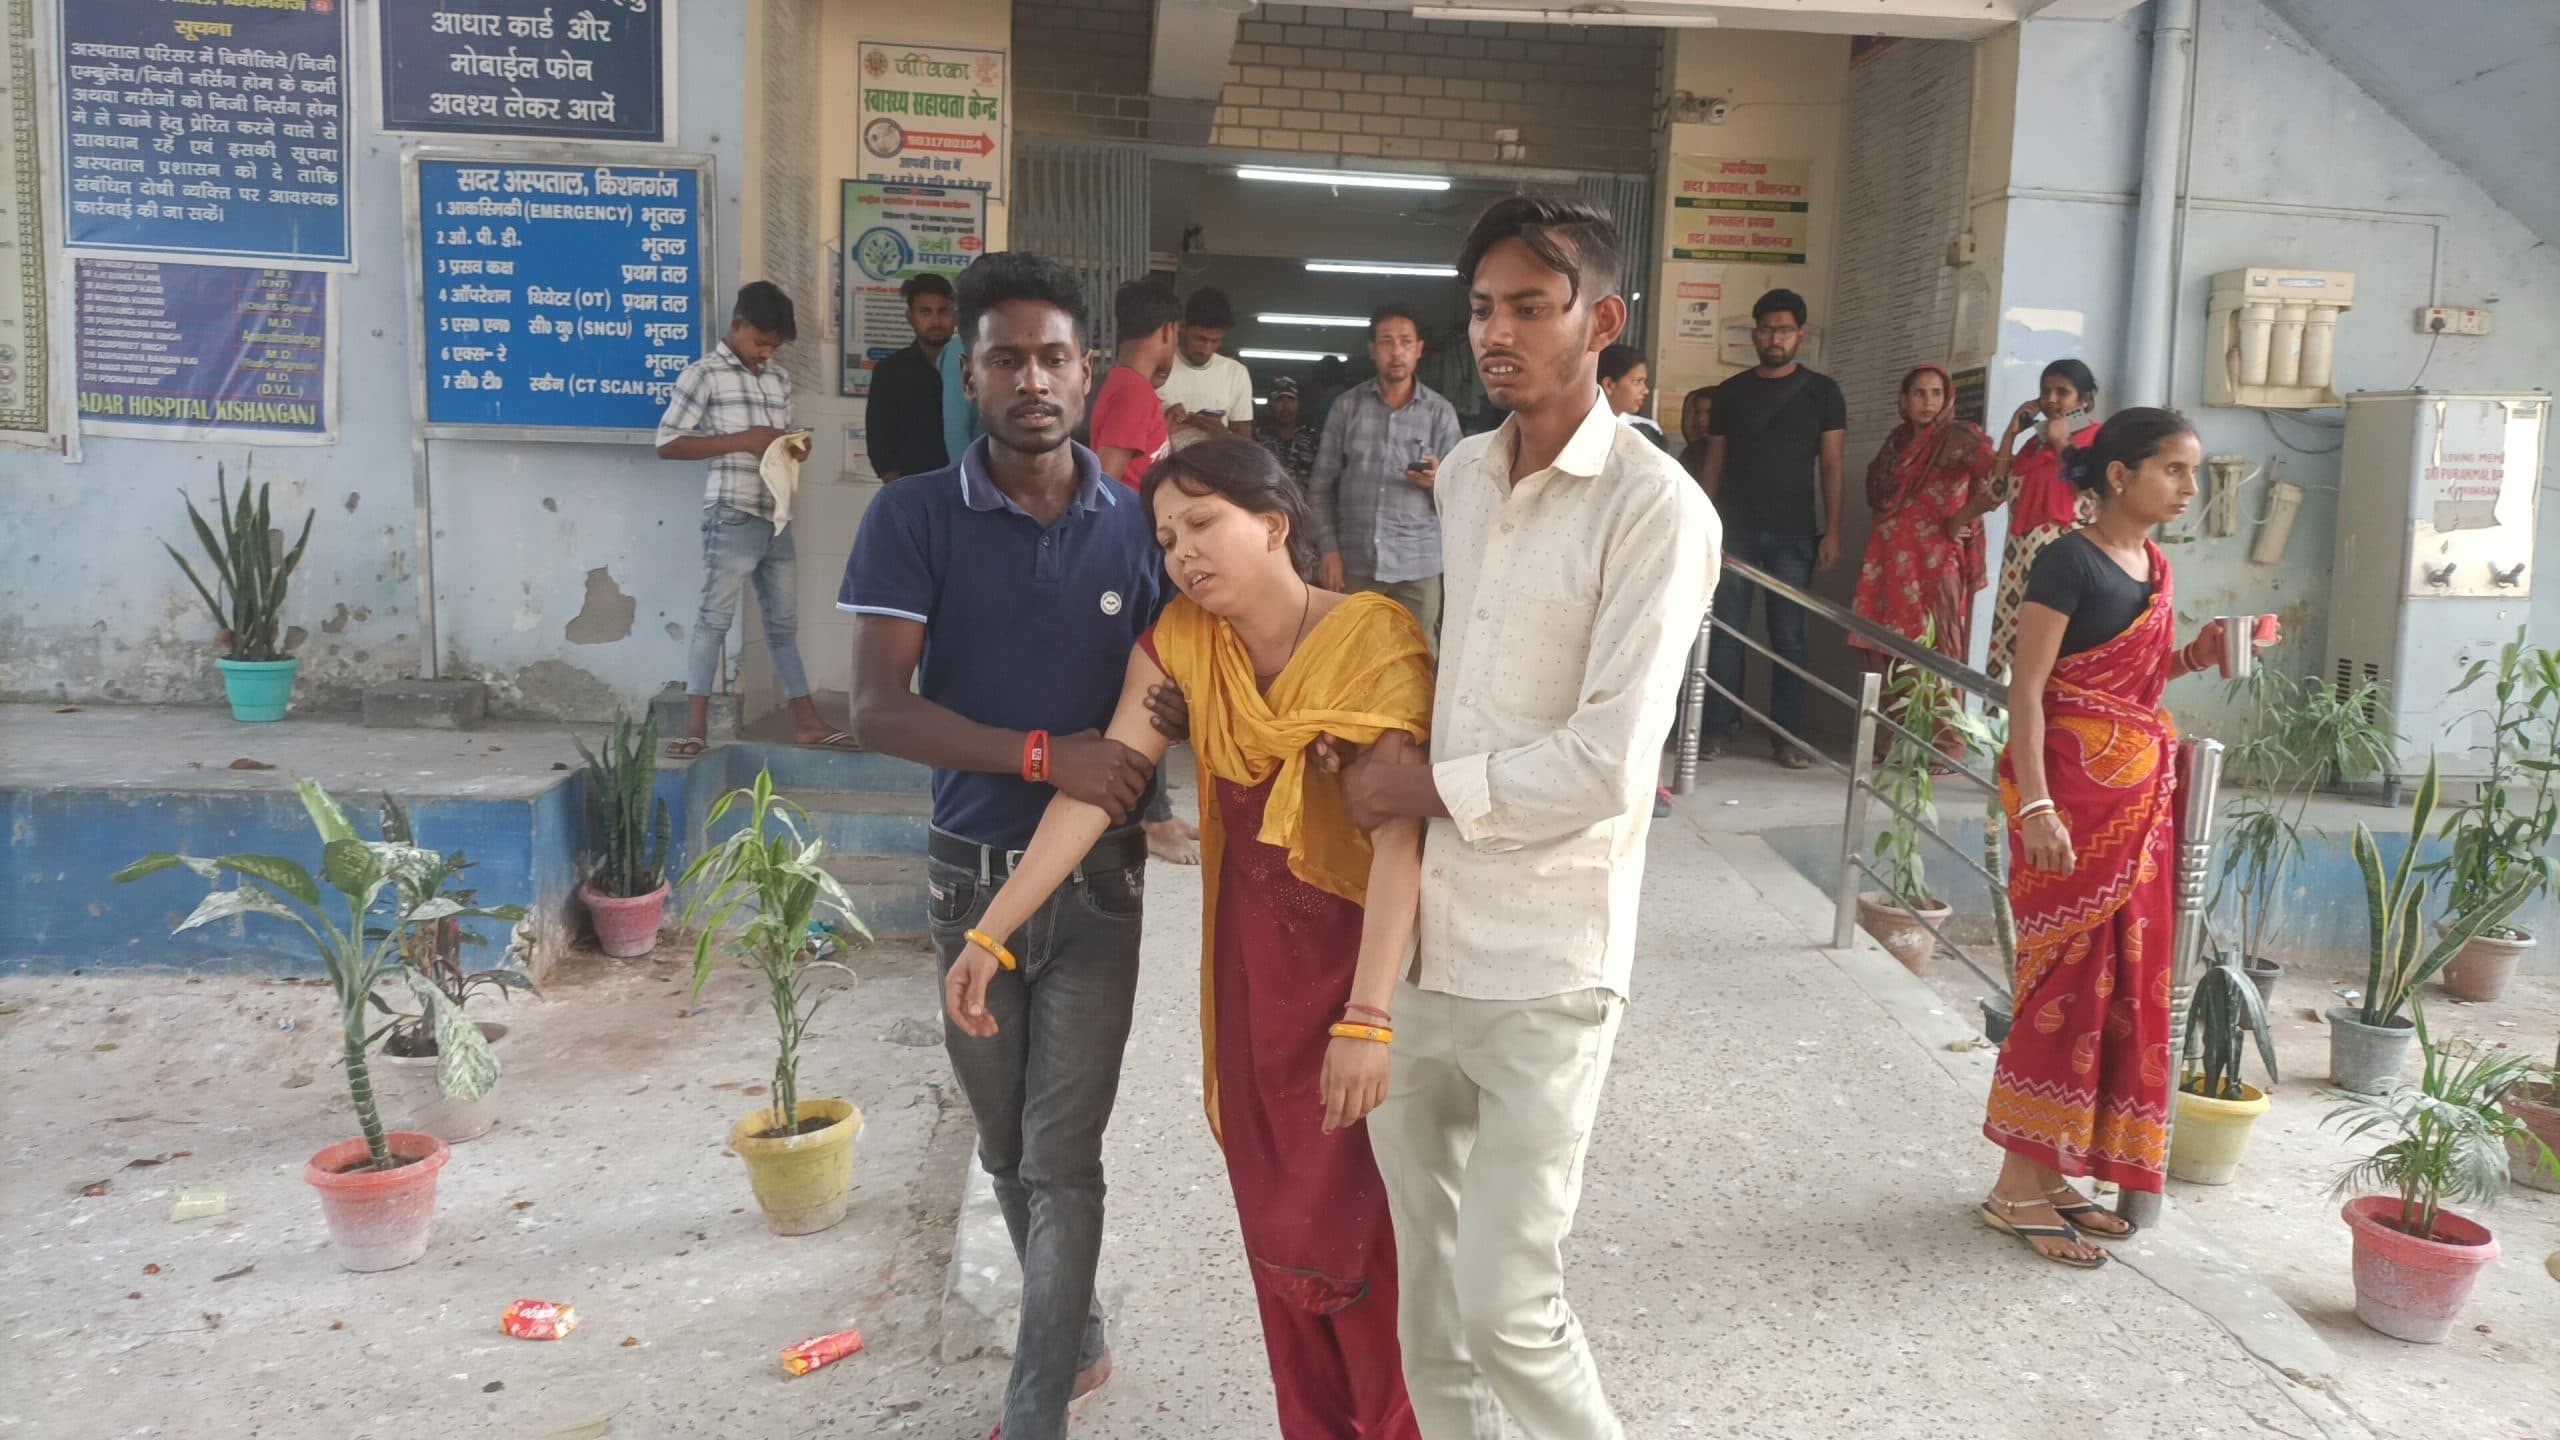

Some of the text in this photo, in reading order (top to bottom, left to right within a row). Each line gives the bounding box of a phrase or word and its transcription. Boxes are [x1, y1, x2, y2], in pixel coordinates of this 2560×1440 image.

[173, 20, 233, 41] सूचना
[431, 8, 612, 42] आधार कार्ड और
[70, 42, 141, 60] अस्पताल
[143, 43, 196, 63] परिसर
[450, 44, 593, 83] मोबाईल फोन
[241, 71, 274, 92] होम
[278, 73, 296, 92] के
[71, 88, 119, 103] अथवा
[180, 89, 204, 108] को
[208, 92, 249, 112] निजी
[305, 97, 338, 118] होम
[428, 92, 498, 116] अवश्य
[503, 87, 561, 120] लेकर
[863, 88, 999, 121] स्वास्थ्य सहायता केन्द्र
[94, 106, 111, 126] ले
[116, 109, 152, 128] जाने
[158, 110, 185, 136] हेतु
[189, 113, 231, 133] प्रेरित
[236, 117, 276, 136] करने
[282, 120, 316, 138] वाले
[321, 121, 338, 139] से
[71, 133, 139, 150] सावधान
[188, 137, 214, 155] एवं
[227, 140, 277, 159] इसकी
[289, 146, 339, 165] सूचना
[73, 156, 145, 173] अस्पताल
[158, 160, 222, 177] प्रशासन
[234, 160, 257, 180] को
[296, 165, 339, 184] ताकि
[456, 167, 679, 198] सदर अस्पताल, किशनगंज
[138, 177, 175, 197] दोषी
[238, 187, 261, 202] पर
[267, 190, 339, 207] आवश्यक
[136, 200, 160, 218] की
[161, 206, 185, 219] जा
[436, 201, 443, 215] 1
[524, 200, 633, 228] (EMERGENCY)
[641, 207, 688, 232] भूतल
[436, 230, 445, 245] 2
[641, 237, 688, 262] भूतल
[437, 259, 446, 273] 3
[448, 259, 483, 276] प्रसव
[621, 264, 658, 285] प्रथम
[660, 266, 689, 283] तल
[438, 288, 448, 302] 4
[574, 287, 612, 313] (OT)
[622, 293, 659, 314] प्रथम
[660, 295, 689, 313] तल
[439, 317, 449, 332] 5
[577, 315, 633, 341] (SNCU)
[643, 322, 690, 347] भूतल
[441, 346, 450, 361] 6
[496, 342, 508, 362] रे
[644, 353, 691, 378] भूतल
[568, 373, 597, 398] (CT
[600, 379, 645, 395] SCAN
[645, 381, 676, 405] भूत
[80, 392, 316, 425] ADAR HOSPITAL KISHANGANJ
